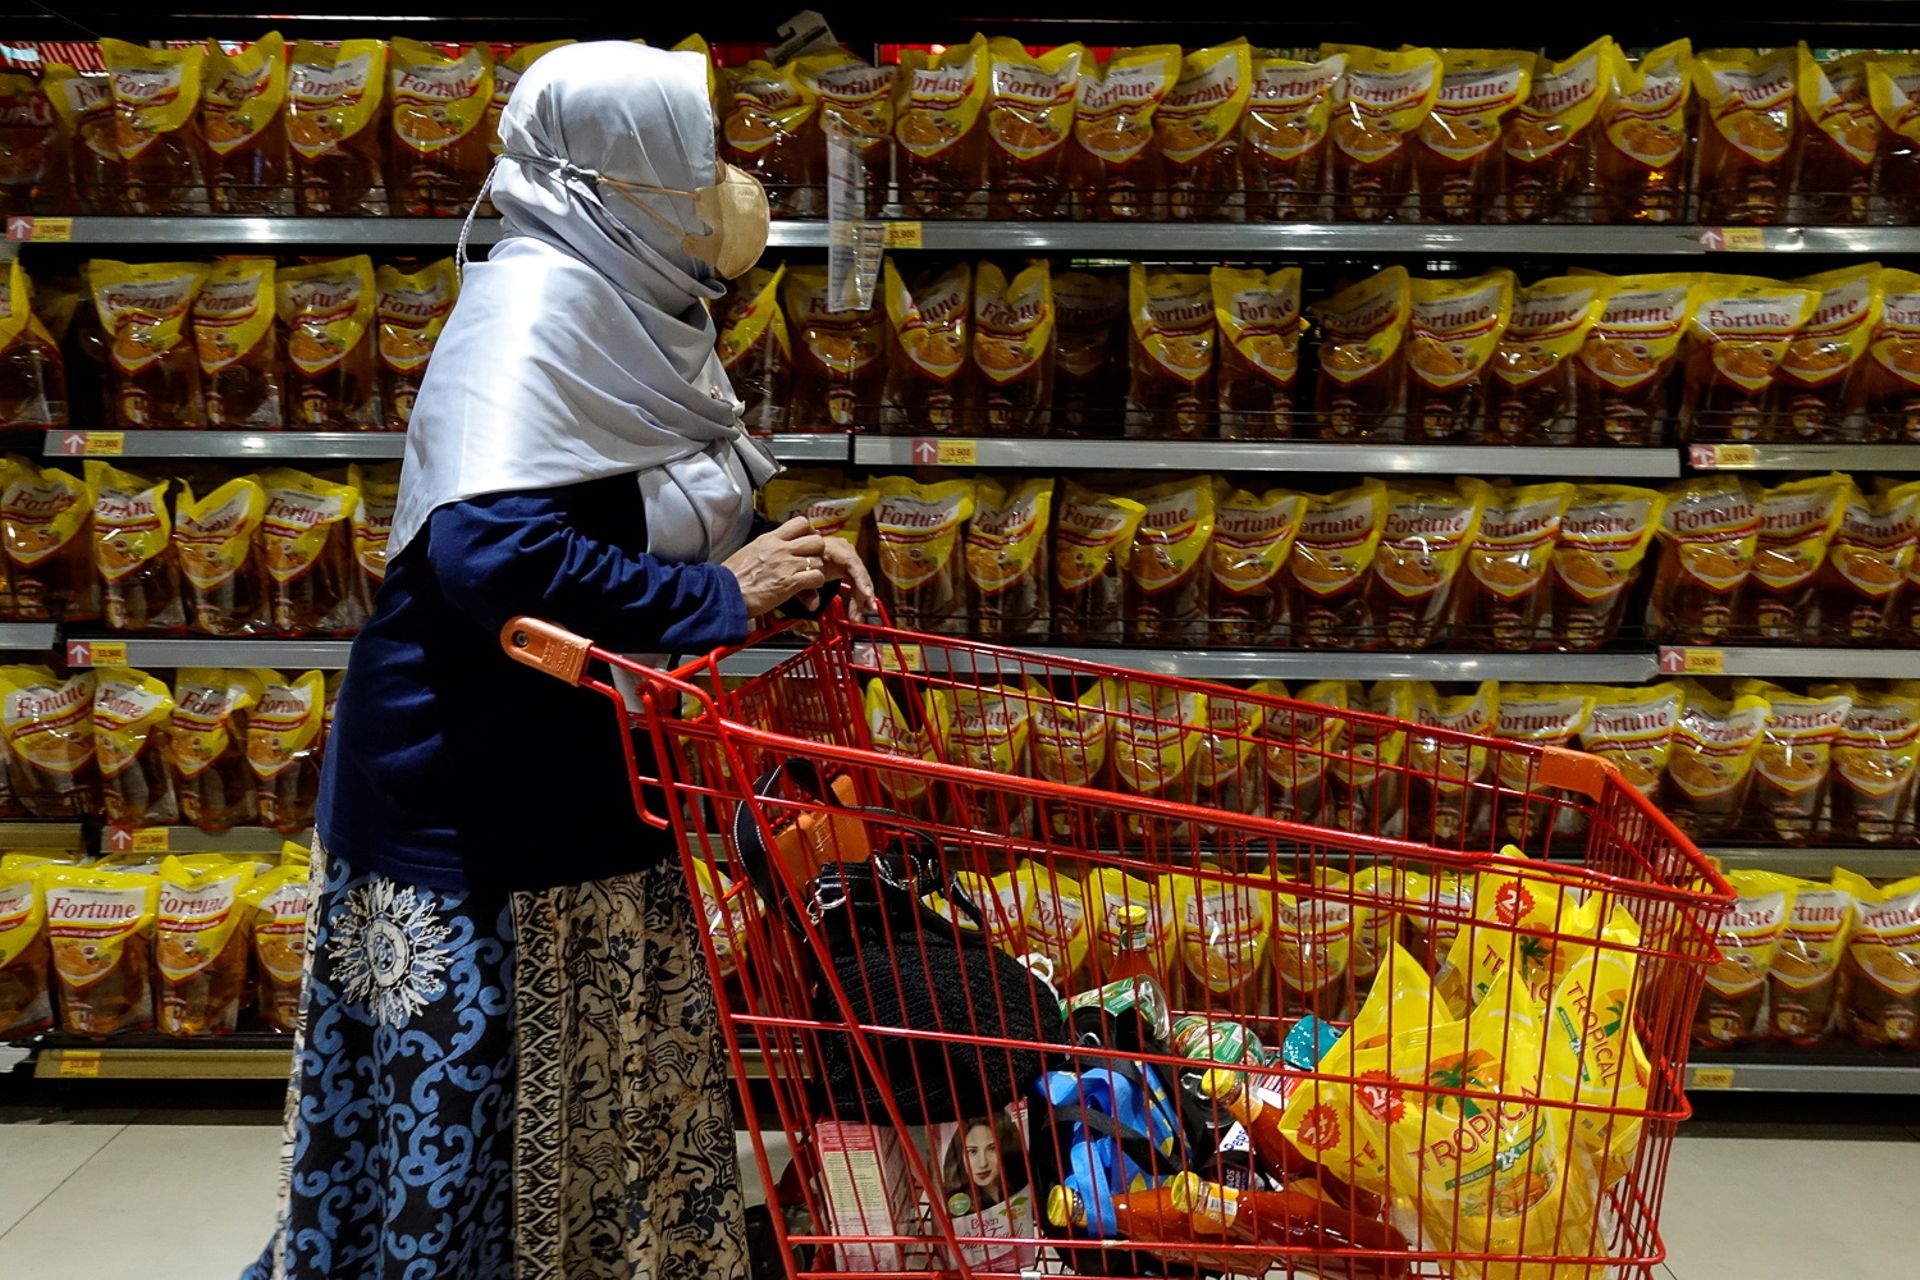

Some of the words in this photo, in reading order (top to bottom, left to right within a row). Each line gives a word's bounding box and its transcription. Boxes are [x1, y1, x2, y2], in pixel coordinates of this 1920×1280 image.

[1437, 80, 1510, 99] ortune
[1601, 306, 1673, 323] ortune
[1708, 309, 1790, 327] Fortune
[1300, 515, 1365, 534] ortune
[1384, 513, 1464, 533] Fortune
[1672, 504, 1755, 531] Fortune
[1760, 506, 1825, 529] ortune
[51, 897, 136, 919] Fortune
[1566, 980, 1619, 1087] TROPICAL
[1407, 1074, 1540, 1173] TROPICA
